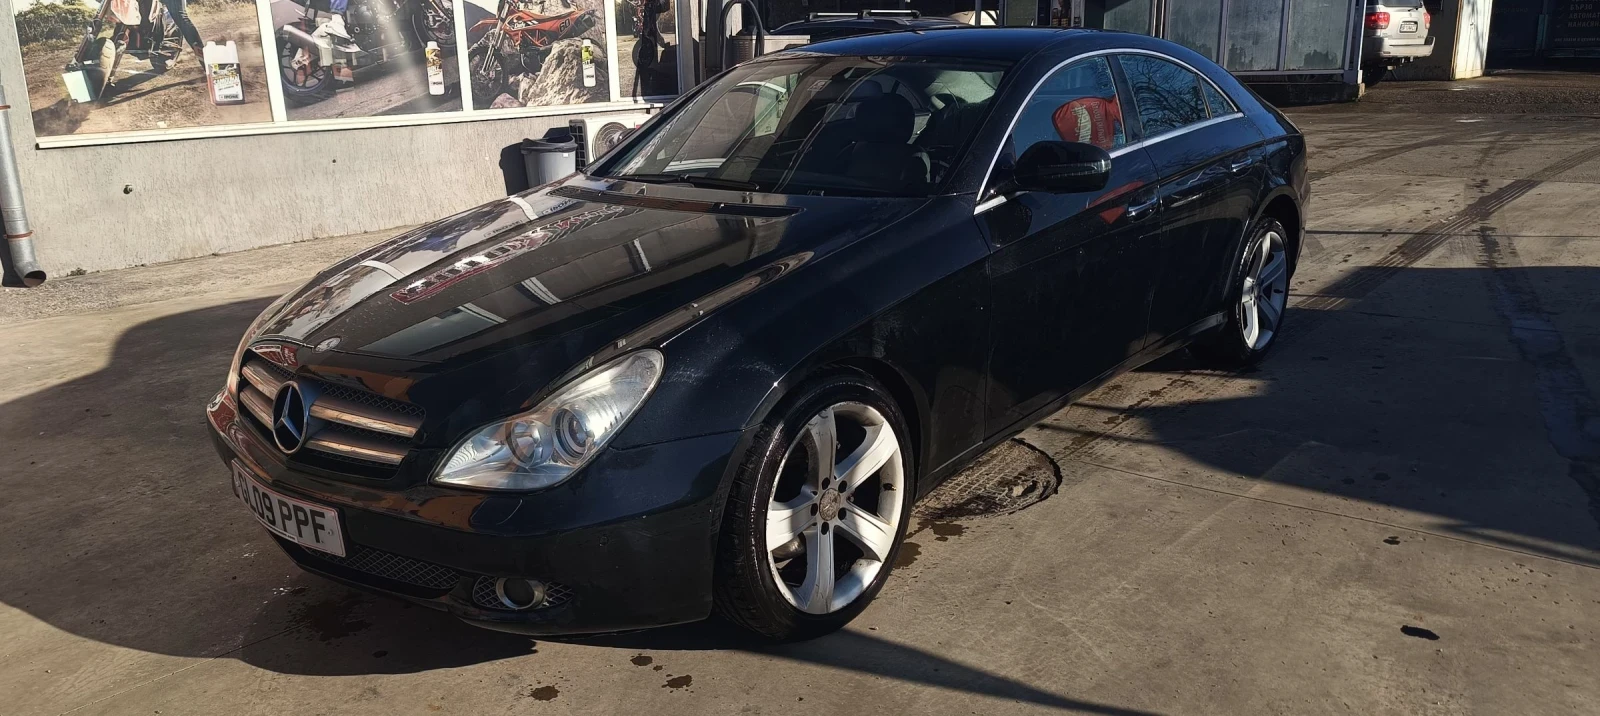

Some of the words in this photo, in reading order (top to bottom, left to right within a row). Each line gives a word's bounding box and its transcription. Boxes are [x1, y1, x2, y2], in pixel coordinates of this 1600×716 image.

[559, 17, 571, 32] 60
[237, 470, 277, 526] GL09
[277, 499, 326, 544] PPF
